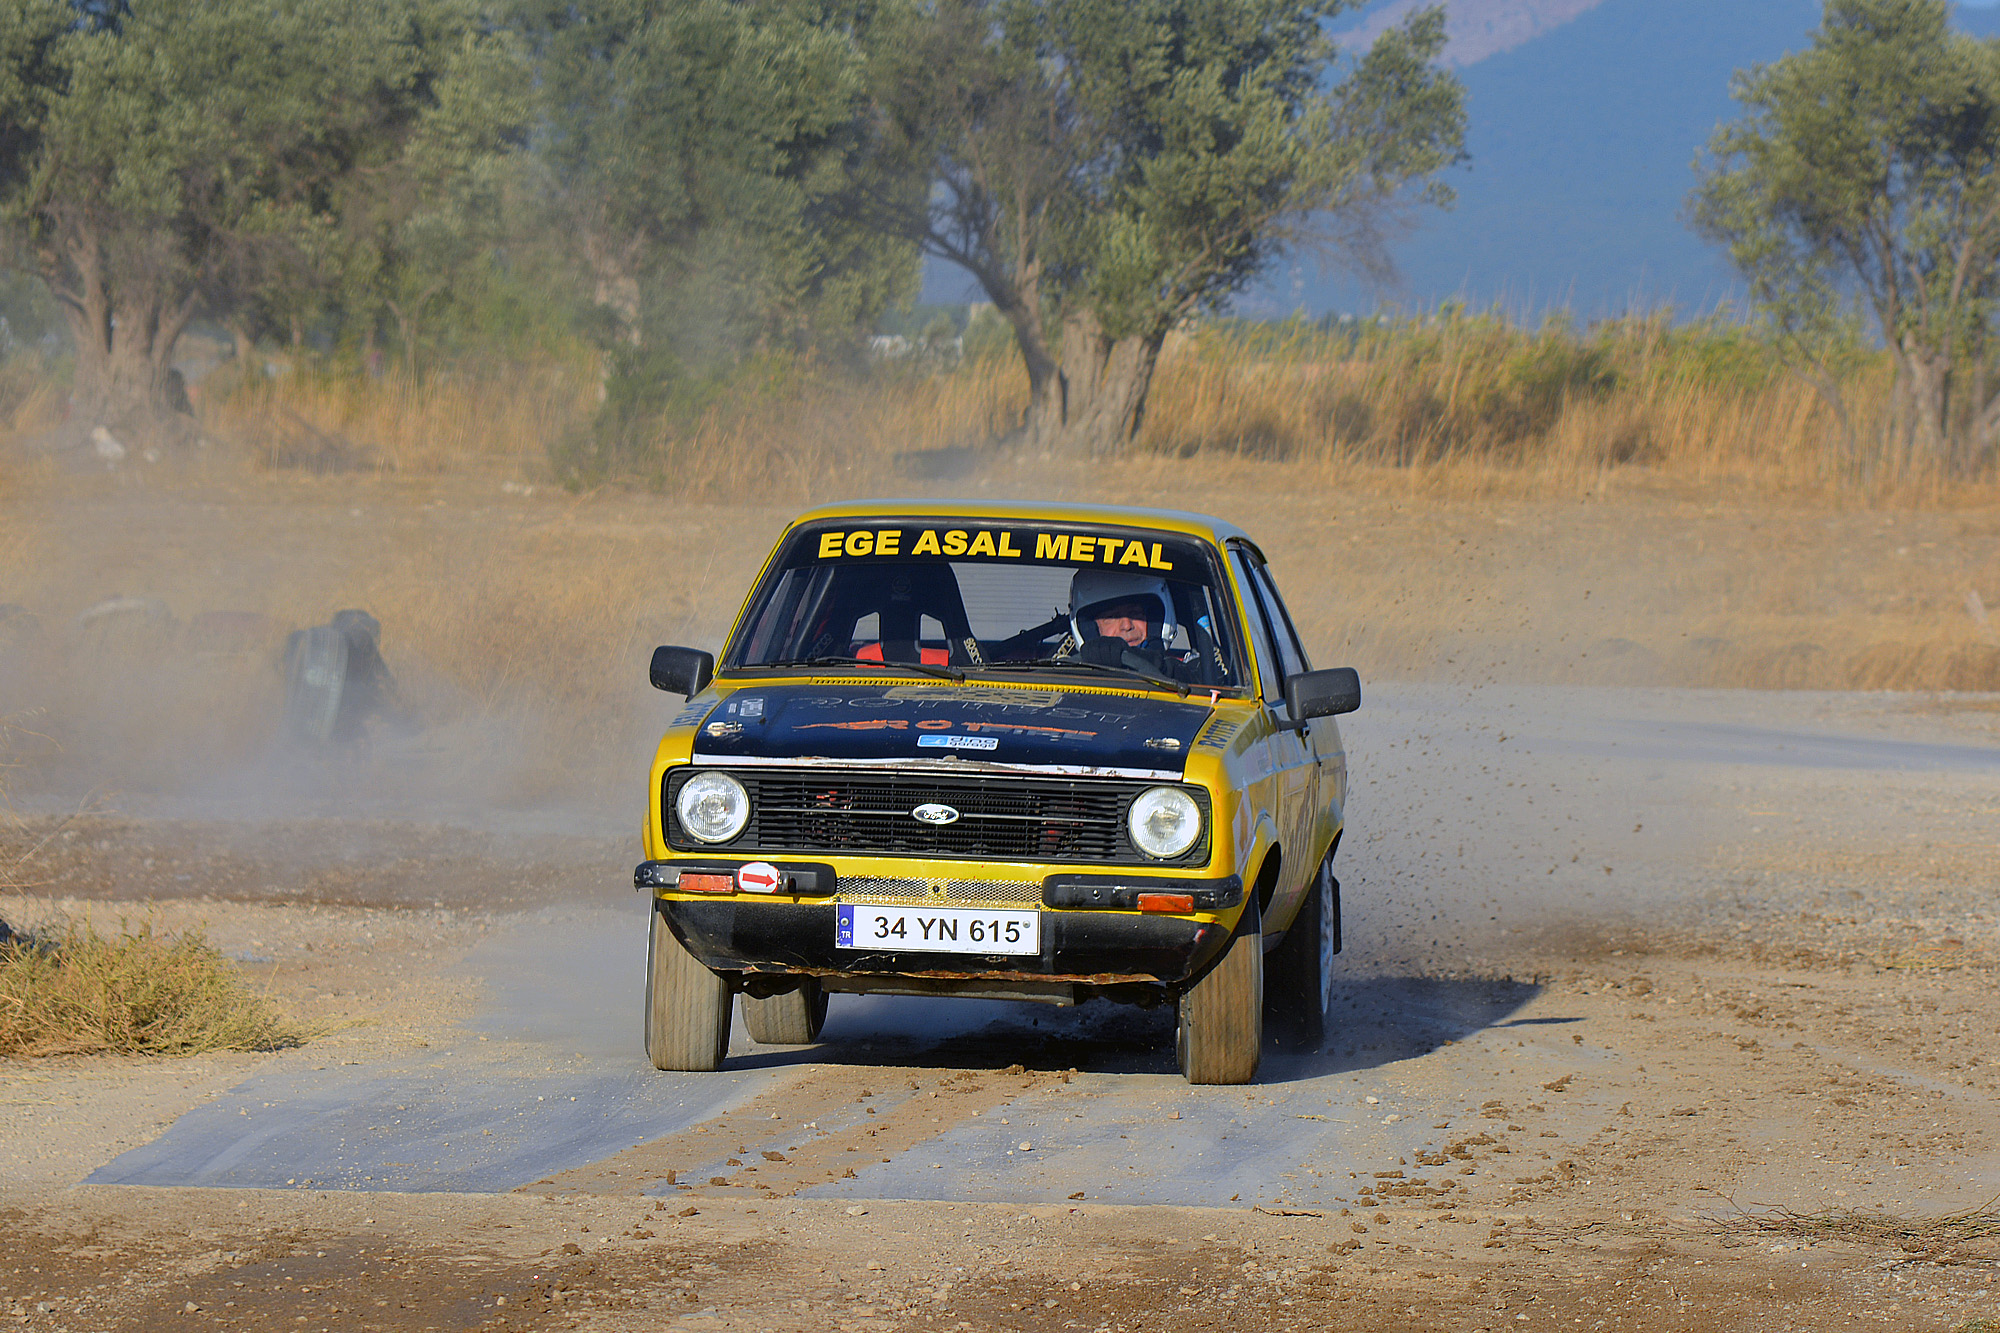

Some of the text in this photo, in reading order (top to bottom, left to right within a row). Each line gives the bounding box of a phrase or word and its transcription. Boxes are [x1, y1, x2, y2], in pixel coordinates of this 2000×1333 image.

[817, 530, 1173, 571] EGE ASAL METAL
[951, 736, 996, 744] dino
[950, 741, 995, 749] garage
[873, 916, 1021, 943] 34 YN 615
[841, 930, 852, 939] TR
